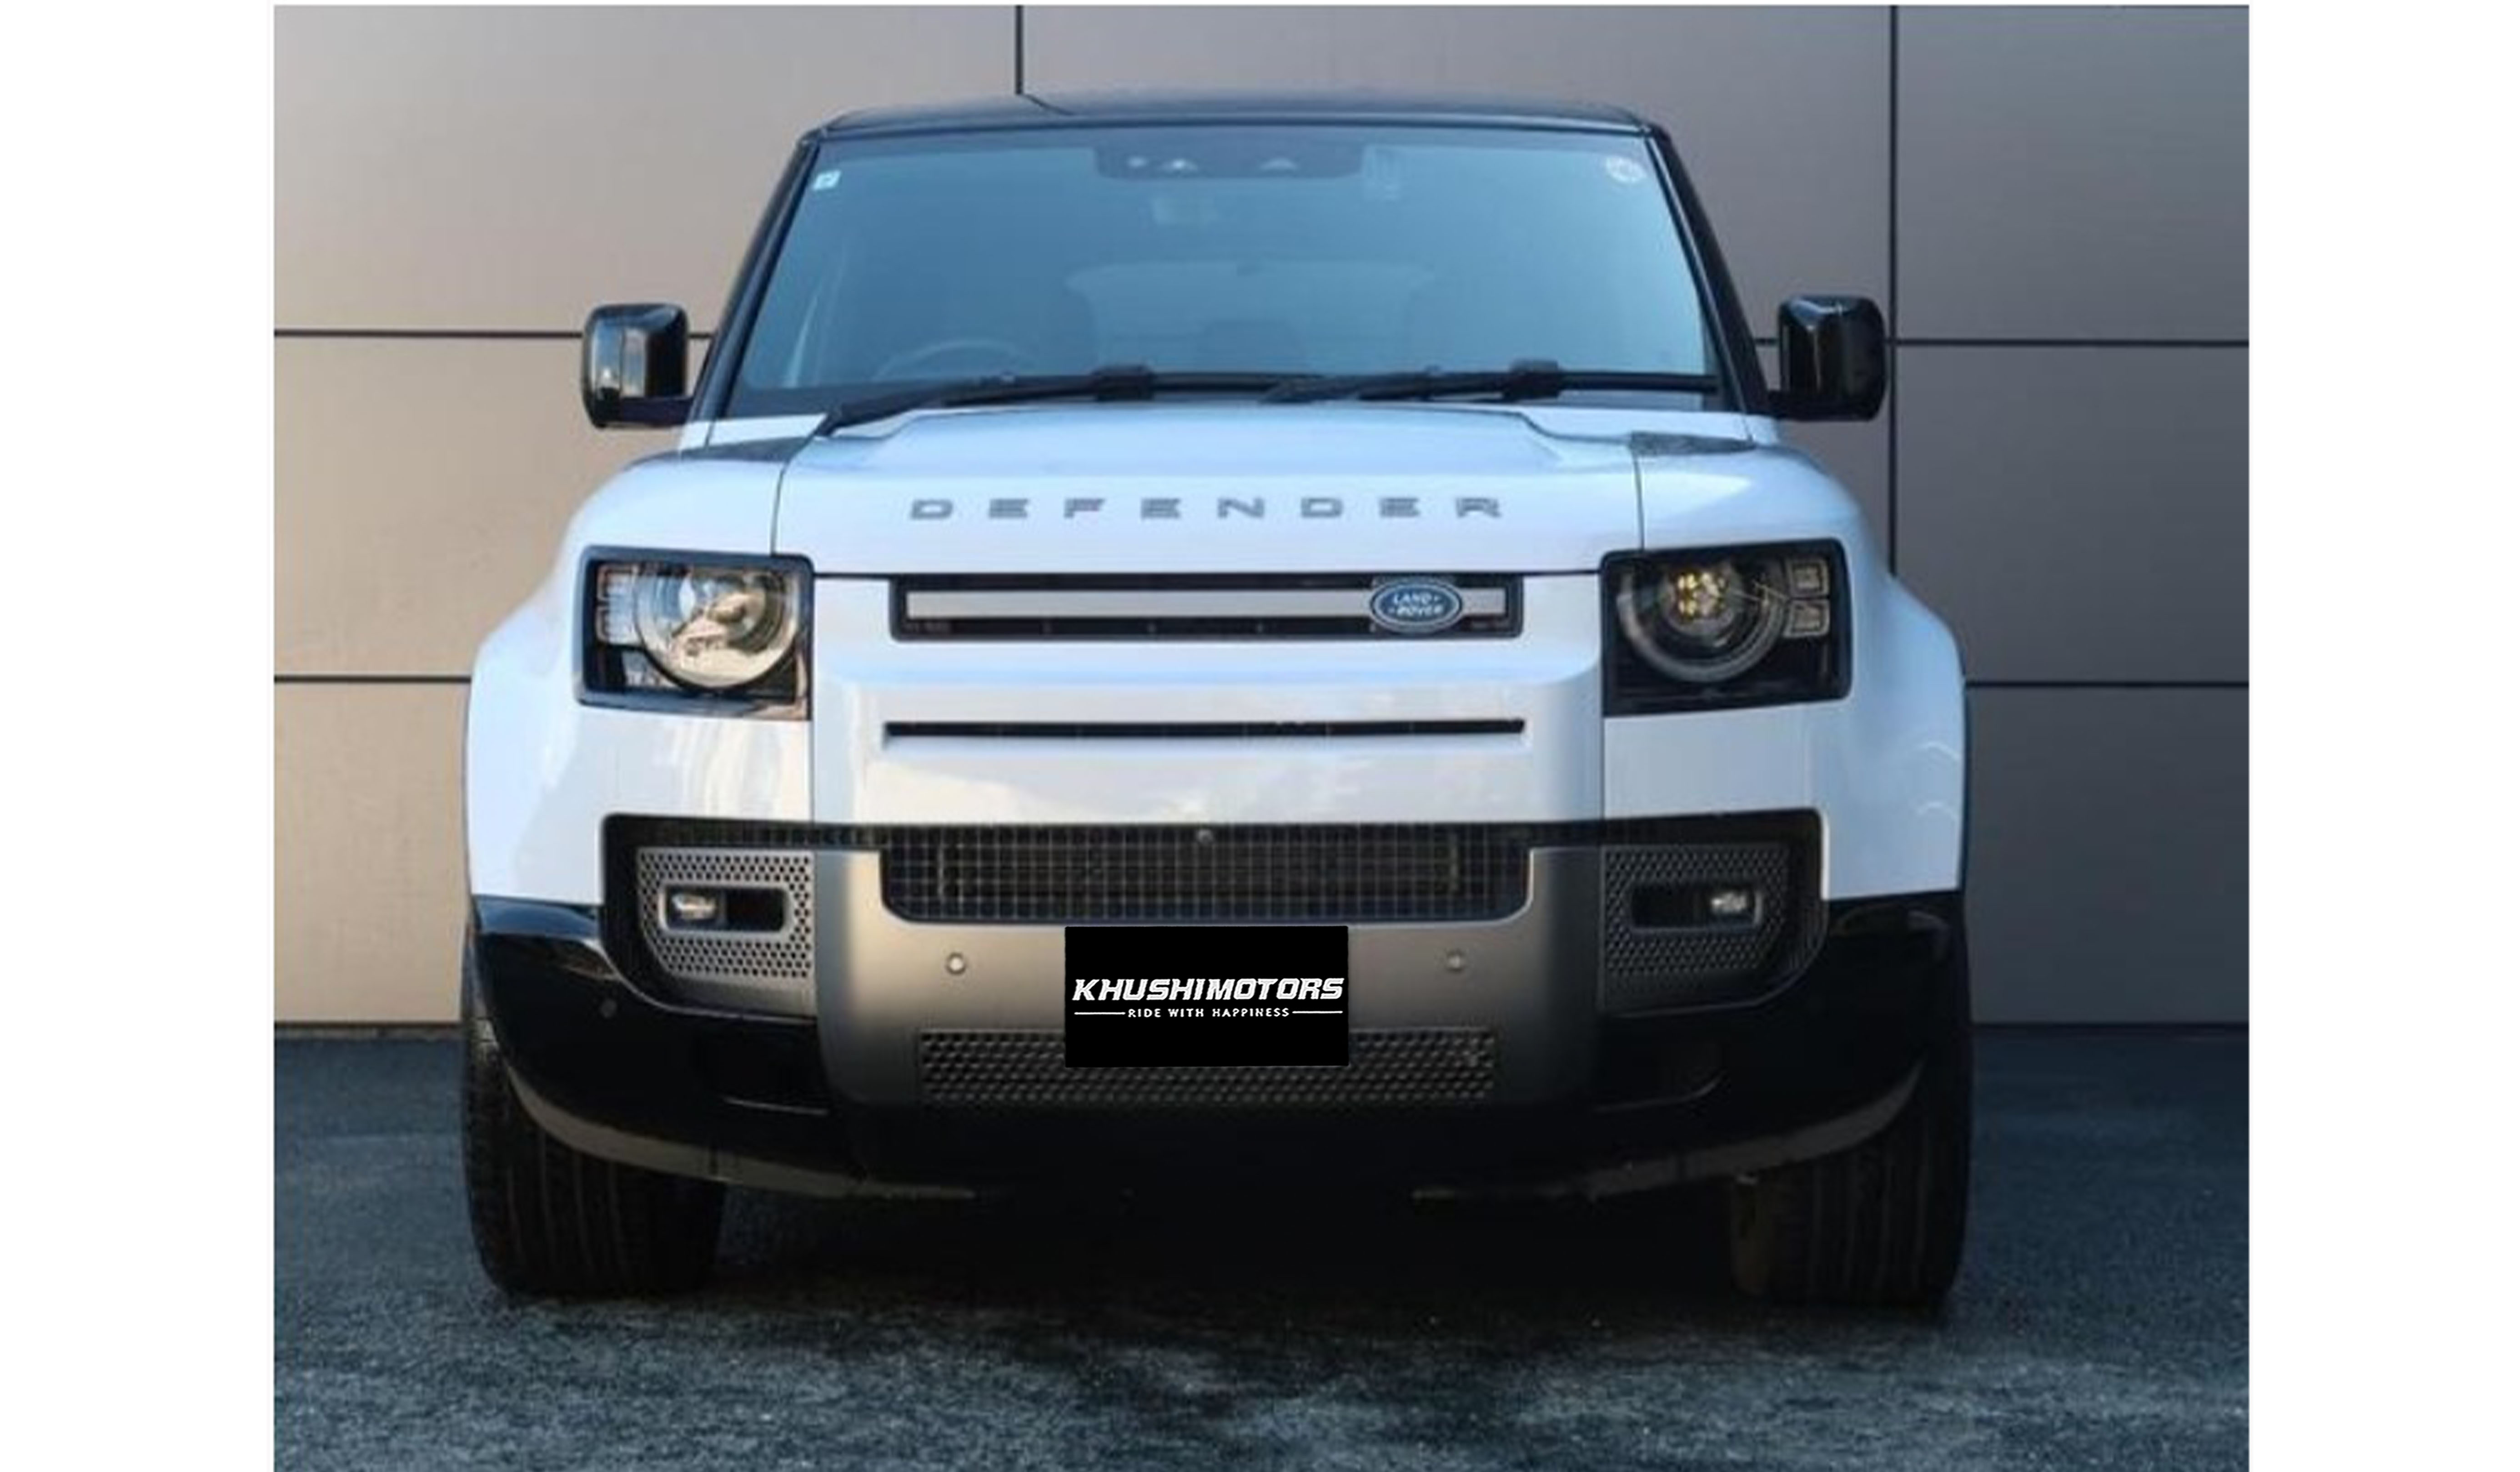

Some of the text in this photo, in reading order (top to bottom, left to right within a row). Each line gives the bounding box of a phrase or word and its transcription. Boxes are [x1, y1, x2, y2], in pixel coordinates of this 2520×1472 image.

[909, 497, 1502, 520] DEFENDER
[1393, 593, 1433, 605] LAND
[1396, 605, 1444, 617] ROVER
